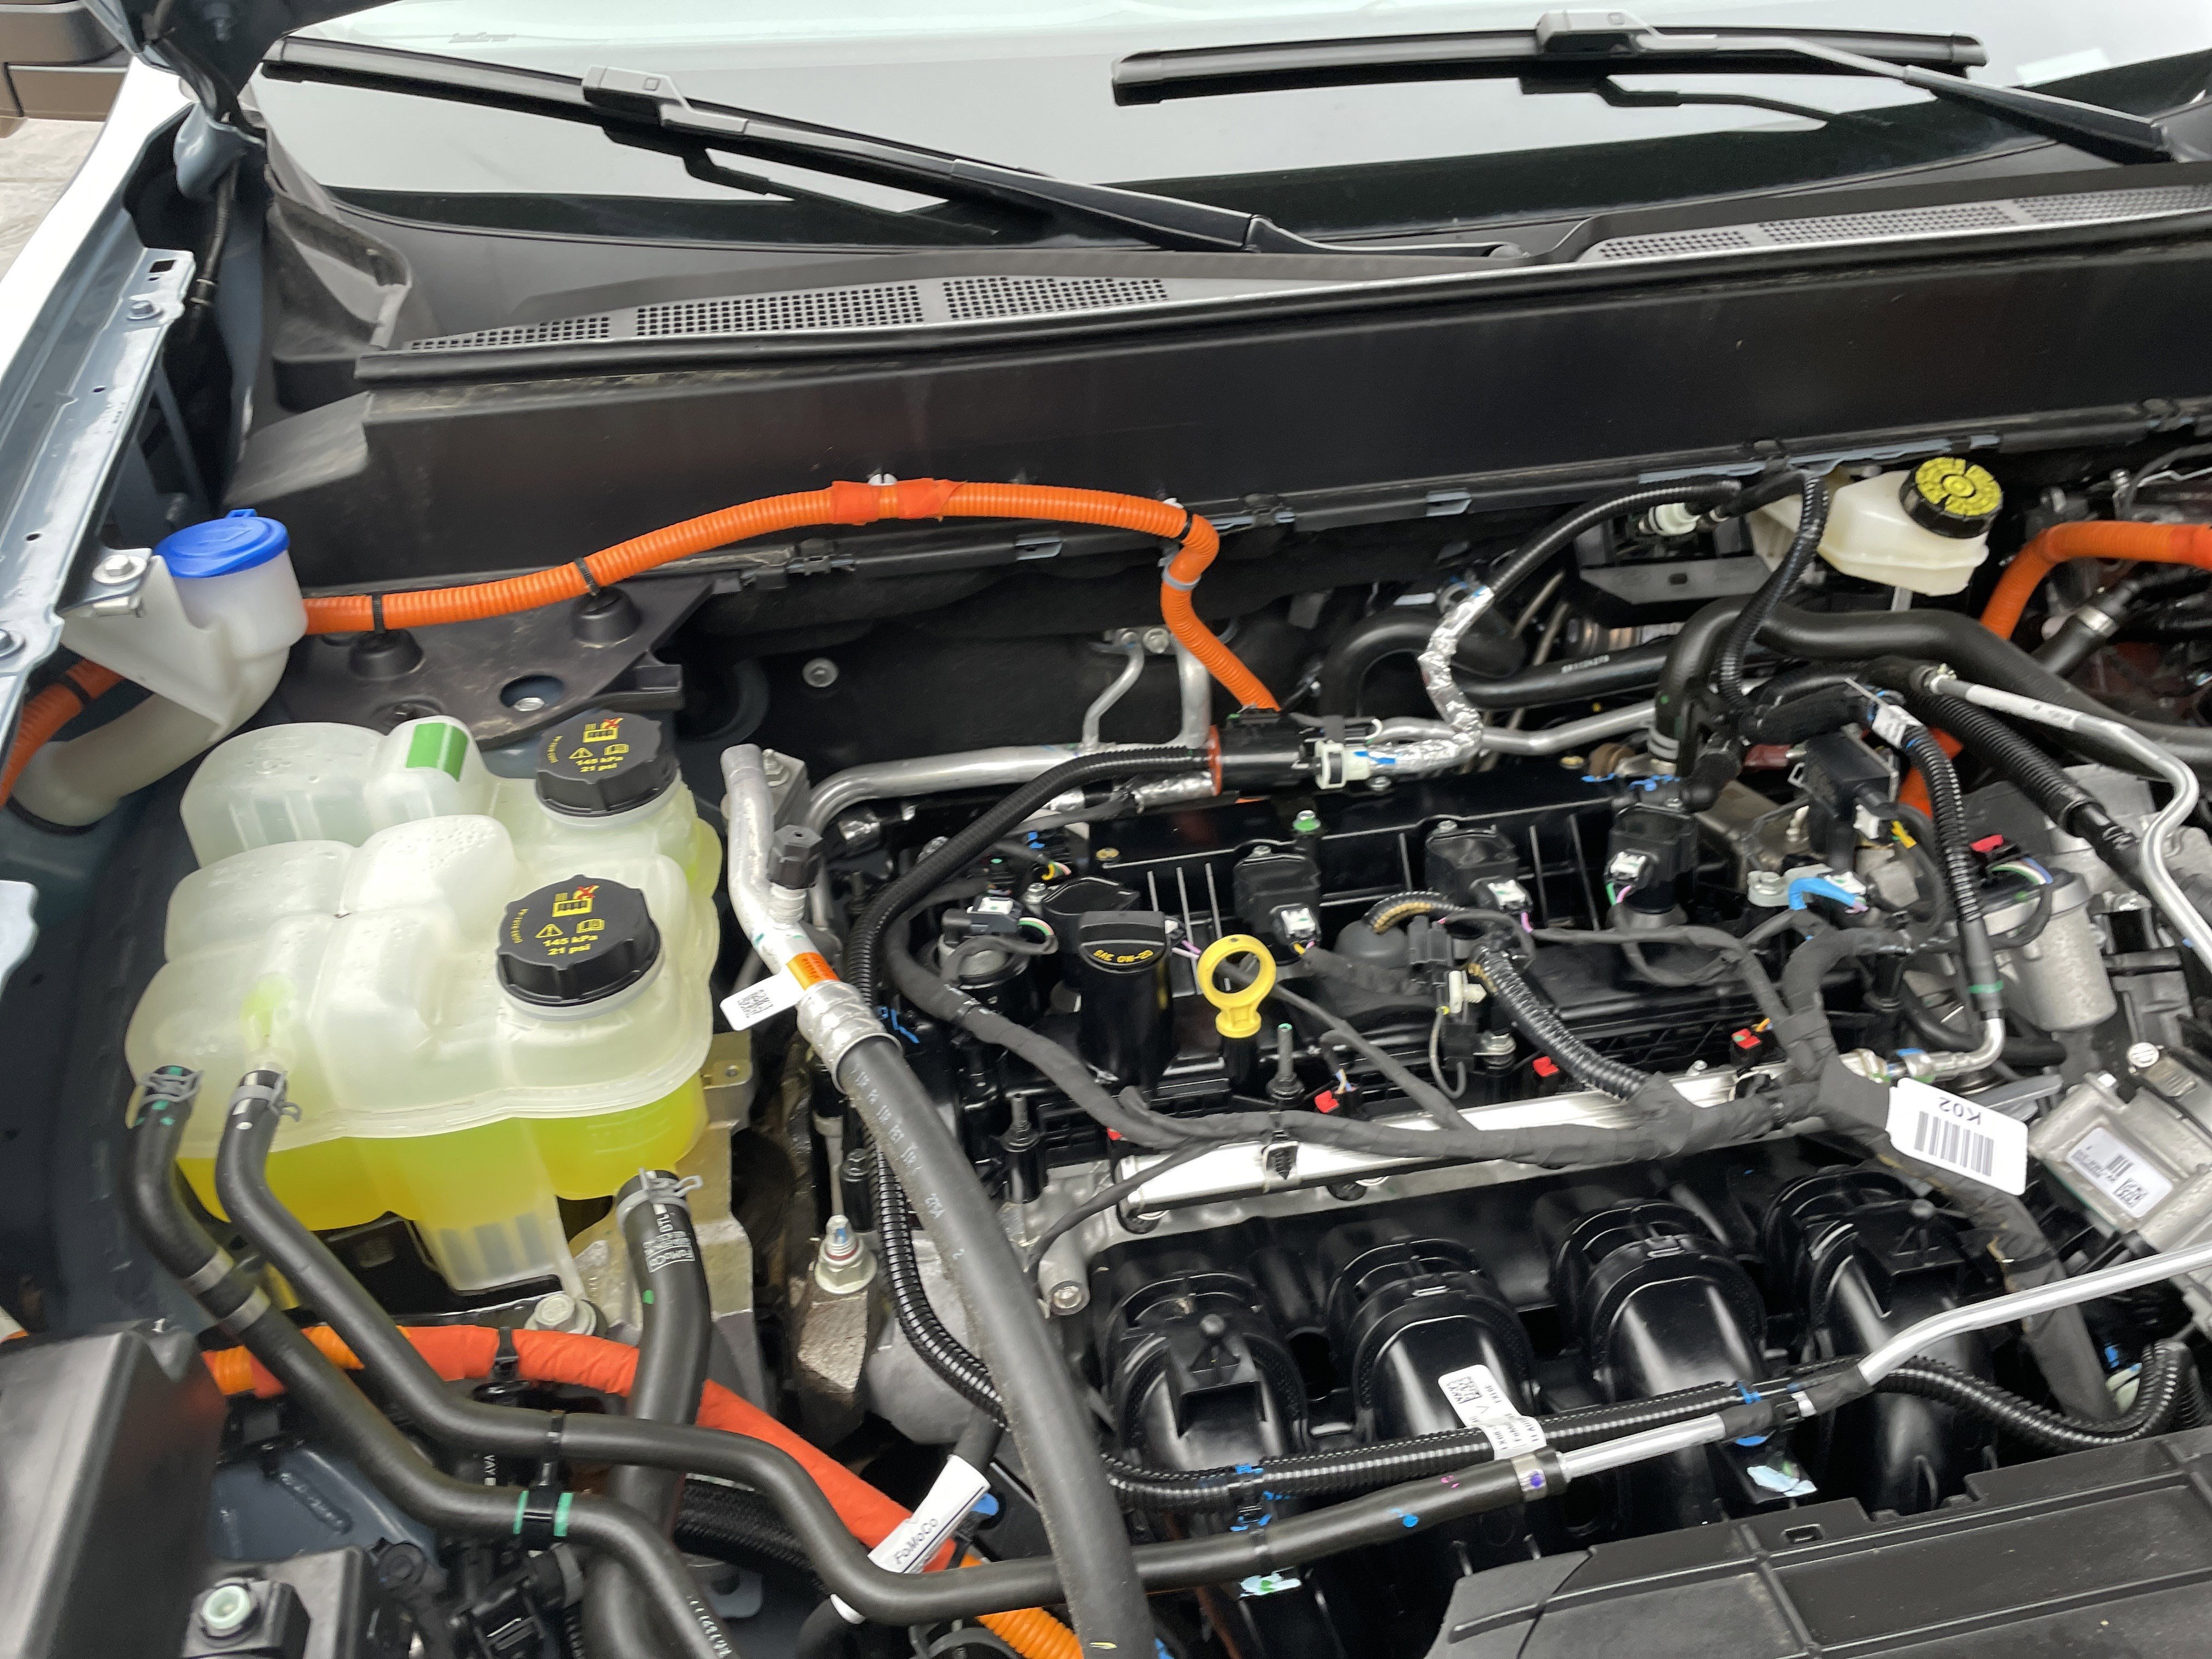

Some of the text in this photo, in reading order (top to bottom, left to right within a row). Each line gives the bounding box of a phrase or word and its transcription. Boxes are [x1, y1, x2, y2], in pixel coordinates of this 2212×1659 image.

[543, 934, 599, 947] 145 kPa
[548, 944, 591, 956] 21 psi
[1938, 1096, 1982, 1125] K02
